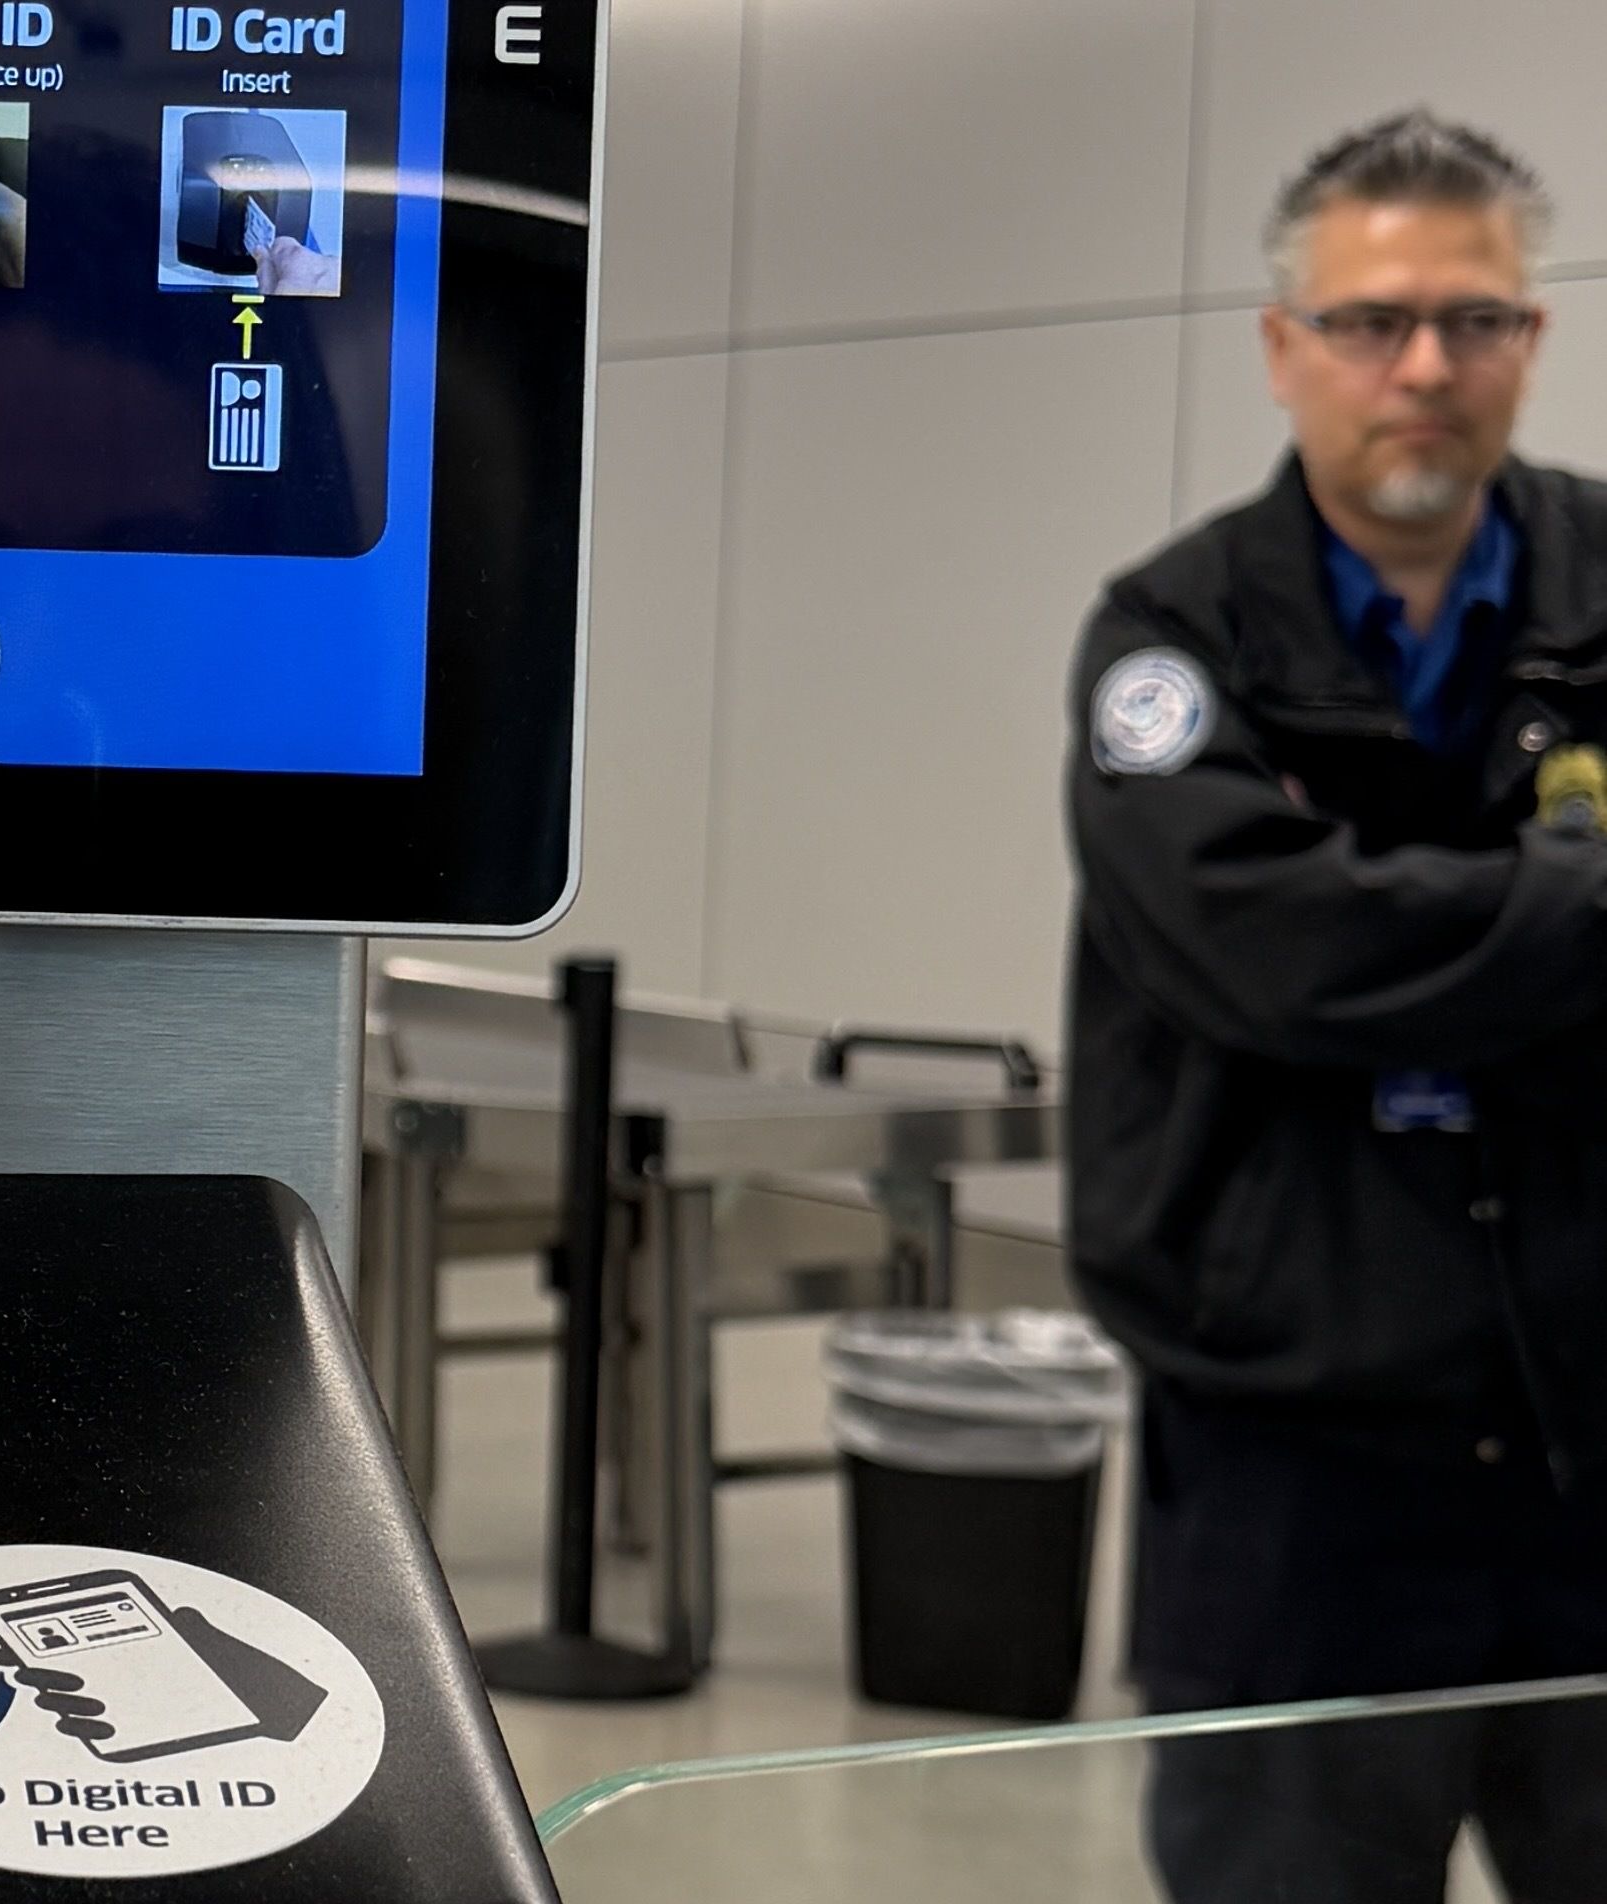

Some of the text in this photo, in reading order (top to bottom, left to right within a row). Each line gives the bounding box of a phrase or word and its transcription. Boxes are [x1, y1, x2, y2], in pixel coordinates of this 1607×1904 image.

[1, 2, 54, 47] ID
[171, 6, 346, 56] ID Card
[25, 63, 64, 91] up)
[222, 69, 292, 94] Insert
[25, 1778, 201, 1812] Digital
[219, 1781, 276, 1807] ID
[34, 1820, 169, 1848] Here
